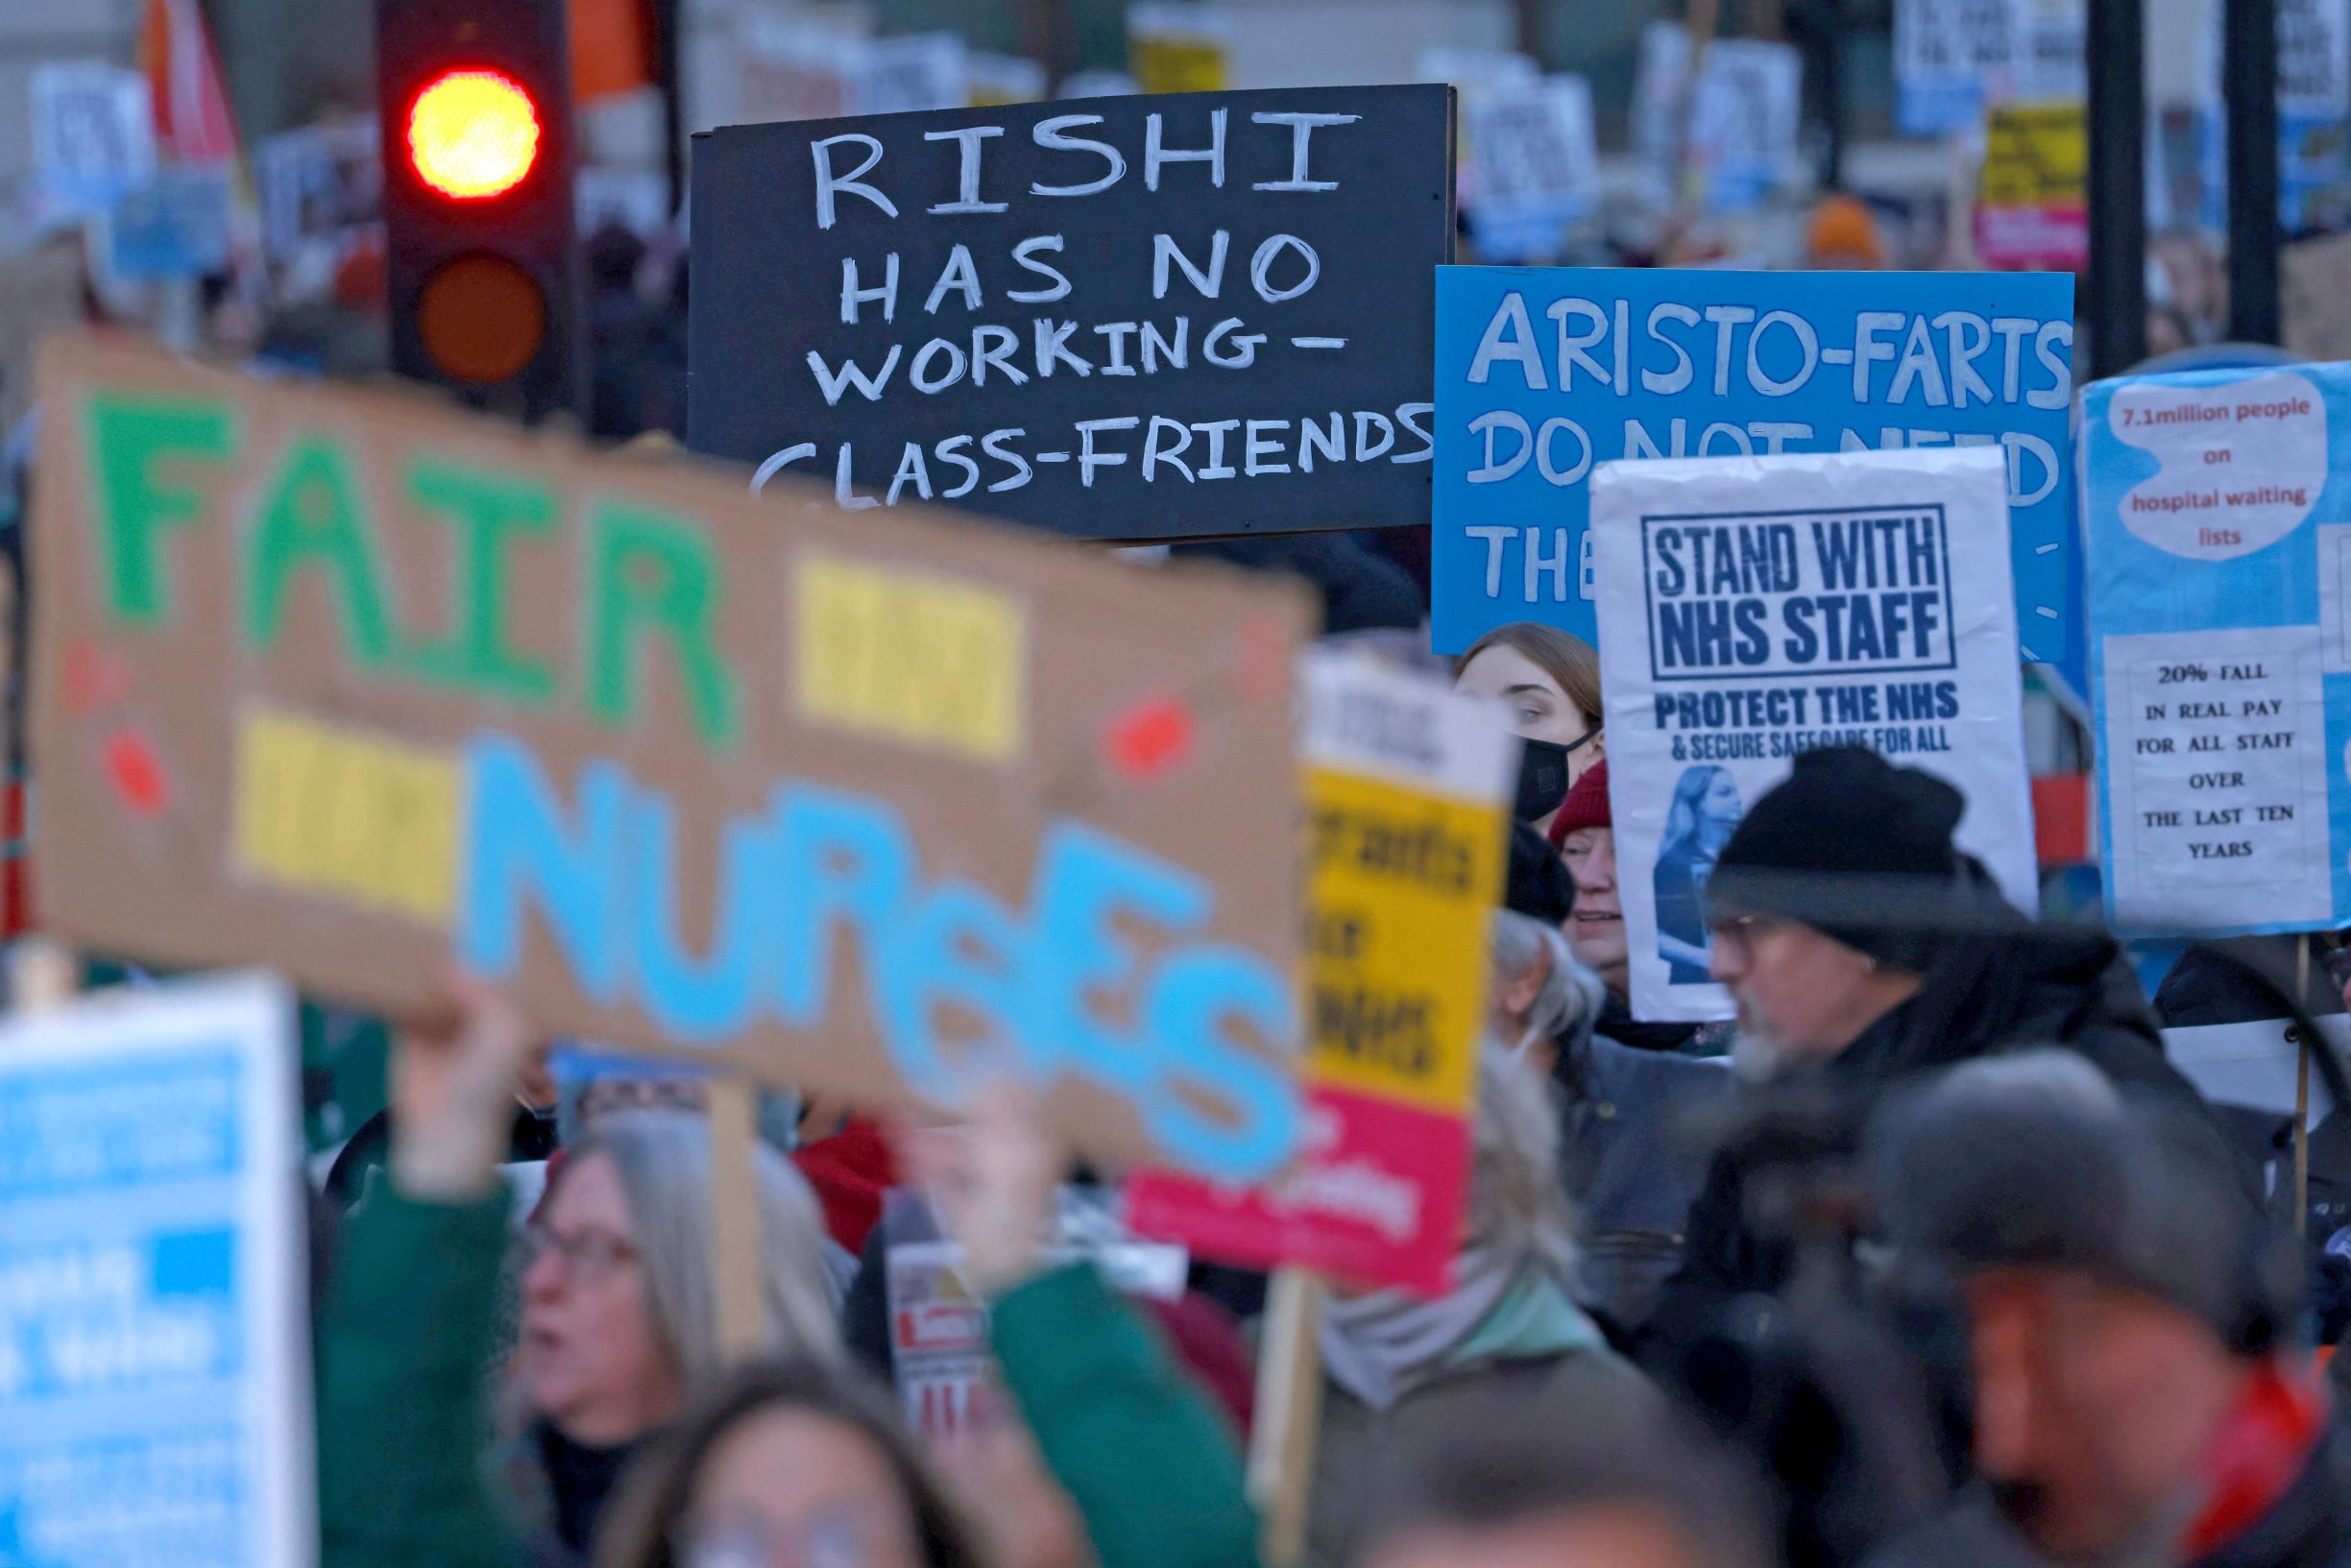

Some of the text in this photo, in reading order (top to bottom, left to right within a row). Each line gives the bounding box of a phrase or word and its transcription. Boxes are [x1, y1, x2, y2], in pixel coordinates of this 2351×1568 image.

[811, 108, 1363, 229] RISHI
[841, 229, 1321, 324] HAS NO
[1466, 292, 2072, 410] ARISTO-FARTS
[2236, 398, 2311, 422] people
[1466, 411, 1592, 486] DO
[2203, 448, 2231, 464] on
[2132, 484, 2306, 513] hospital waiting
[2198, 528, 2242, 545] lists
[79, 392, 745, 751] FAIR
[1655, 517, 1937, 597] STAND WITH
[1659, 591, 1940, 668] NHS STAFF
[2159, 663, 2267, 685] 20% FALL
[1654, 681, 1959, 729] PROTECT THE NHS
[2145, 700, 2283, 720] IN REAL PAY
[1671, 735, 1687, 760] &
[1690, 733, 1765, 760] SECURE
[1874, 725, 1912, 753] FOR
[1916, 725, 1951, 751] ALL
[2136, 733, 2296, 754] FOR ALL STAFF
[2189, 773, 2244, 790] OVER
[2144, 806, 2294, 827] THE LAST TEN
[2189, 842, 2253, 859] YEARS
